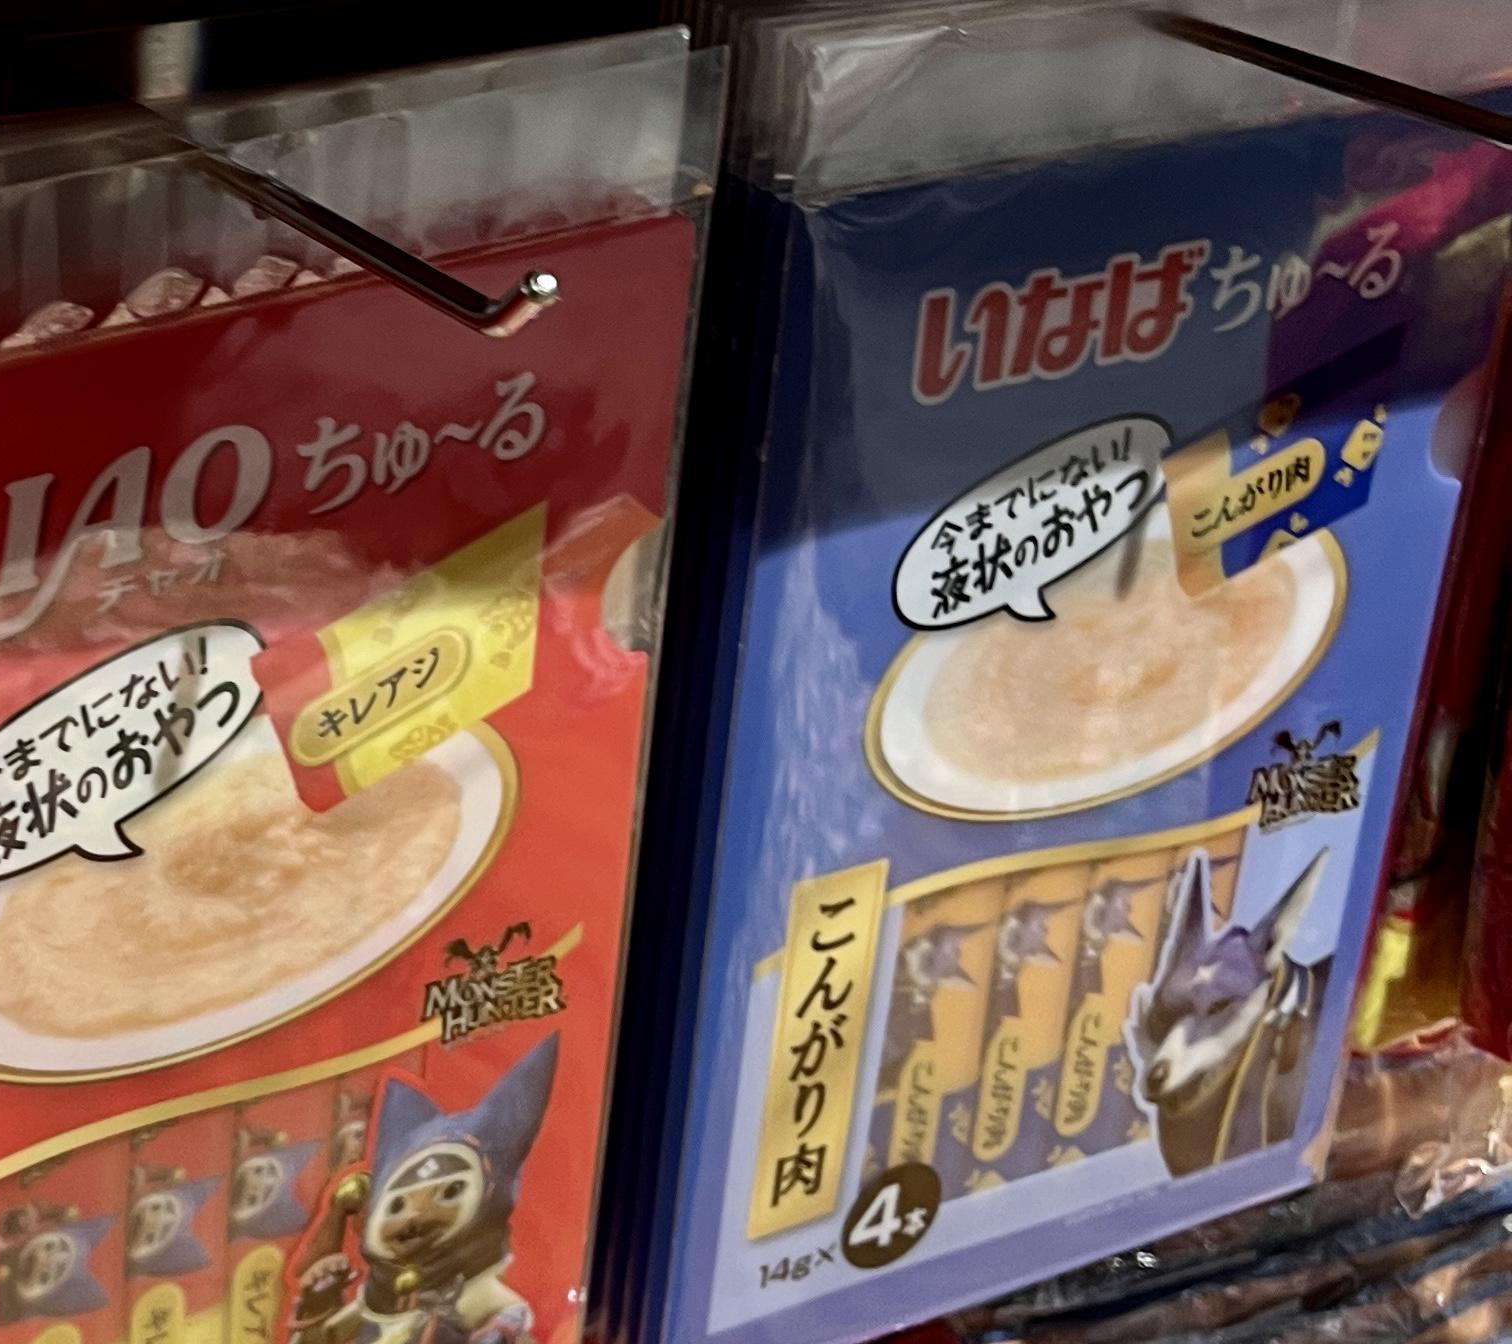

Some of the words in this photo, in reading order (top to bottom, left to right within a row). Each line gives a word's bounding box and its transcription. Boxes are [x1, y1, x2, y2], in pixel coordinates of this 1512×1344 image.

[912, 239, 1212, 406] いなば
[931, 469, 1151, 620] 液状のおやつ
[316, 647, 440, 740] キレアジ
[422, 954, 559, 1018] MONSTER
[441, 981, 566, 1045] HUNTER
[769, 895, 857, 1208] こんがり肉
